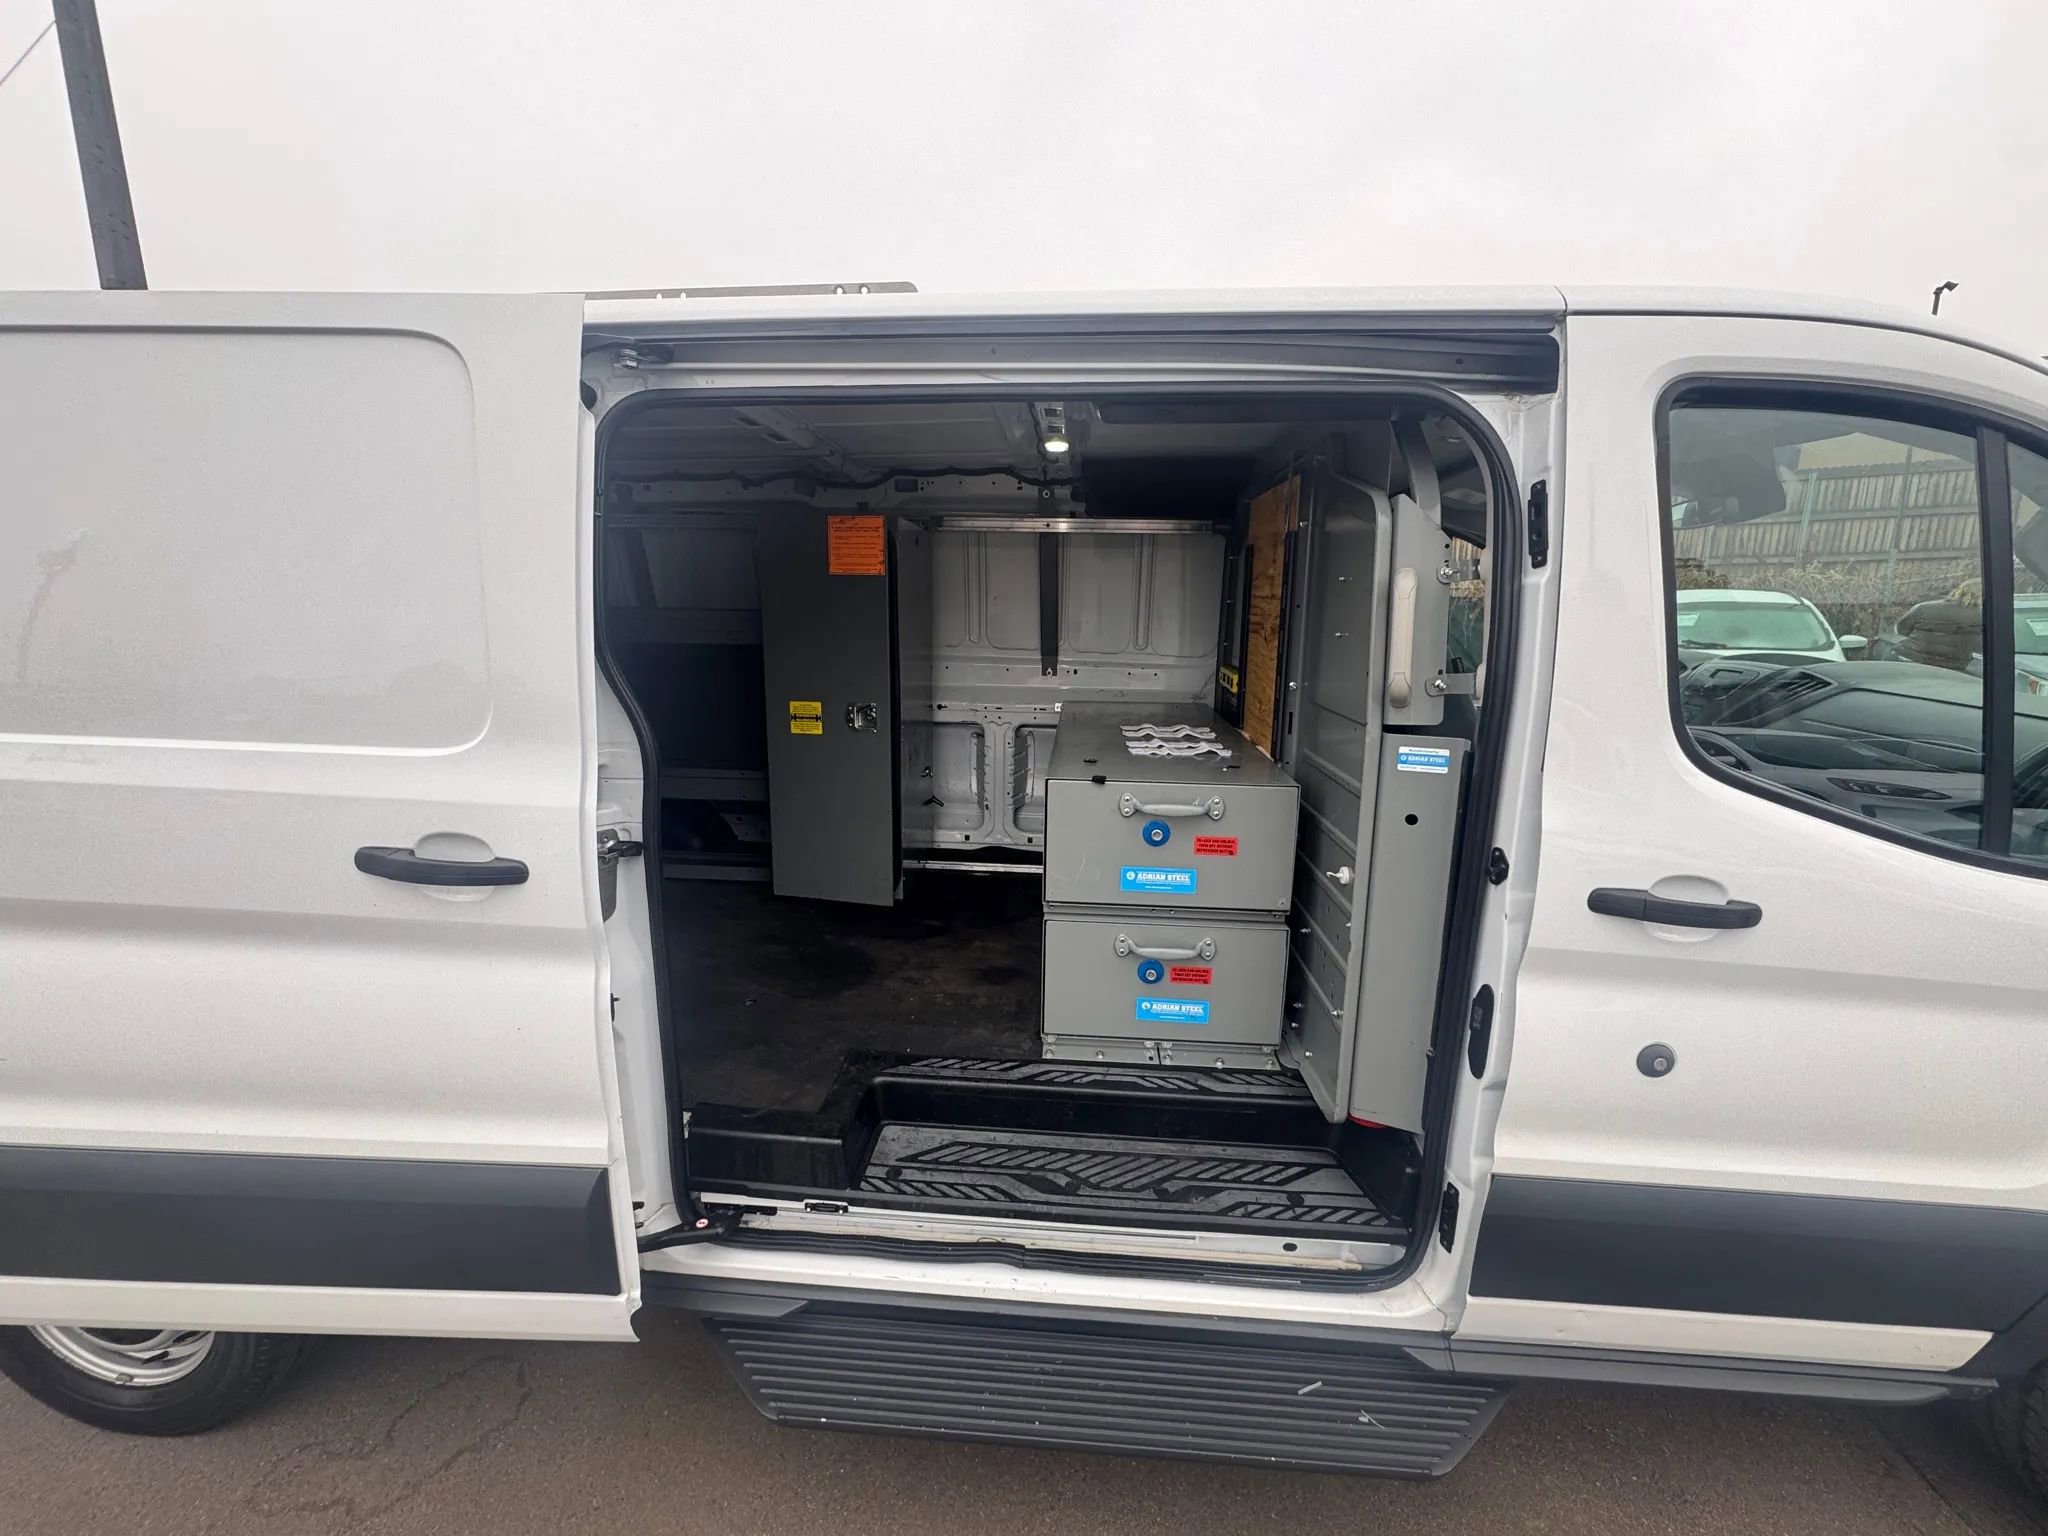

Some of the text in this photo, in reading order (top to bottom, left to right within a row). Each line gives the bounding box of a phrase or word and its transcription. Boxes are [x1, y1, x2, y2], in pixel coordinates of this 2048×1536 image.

[1136, 873, 1191, 882] ADRIAN STEEL
[1151, 1003, 1204, 1012] ADRIAN STEEL
